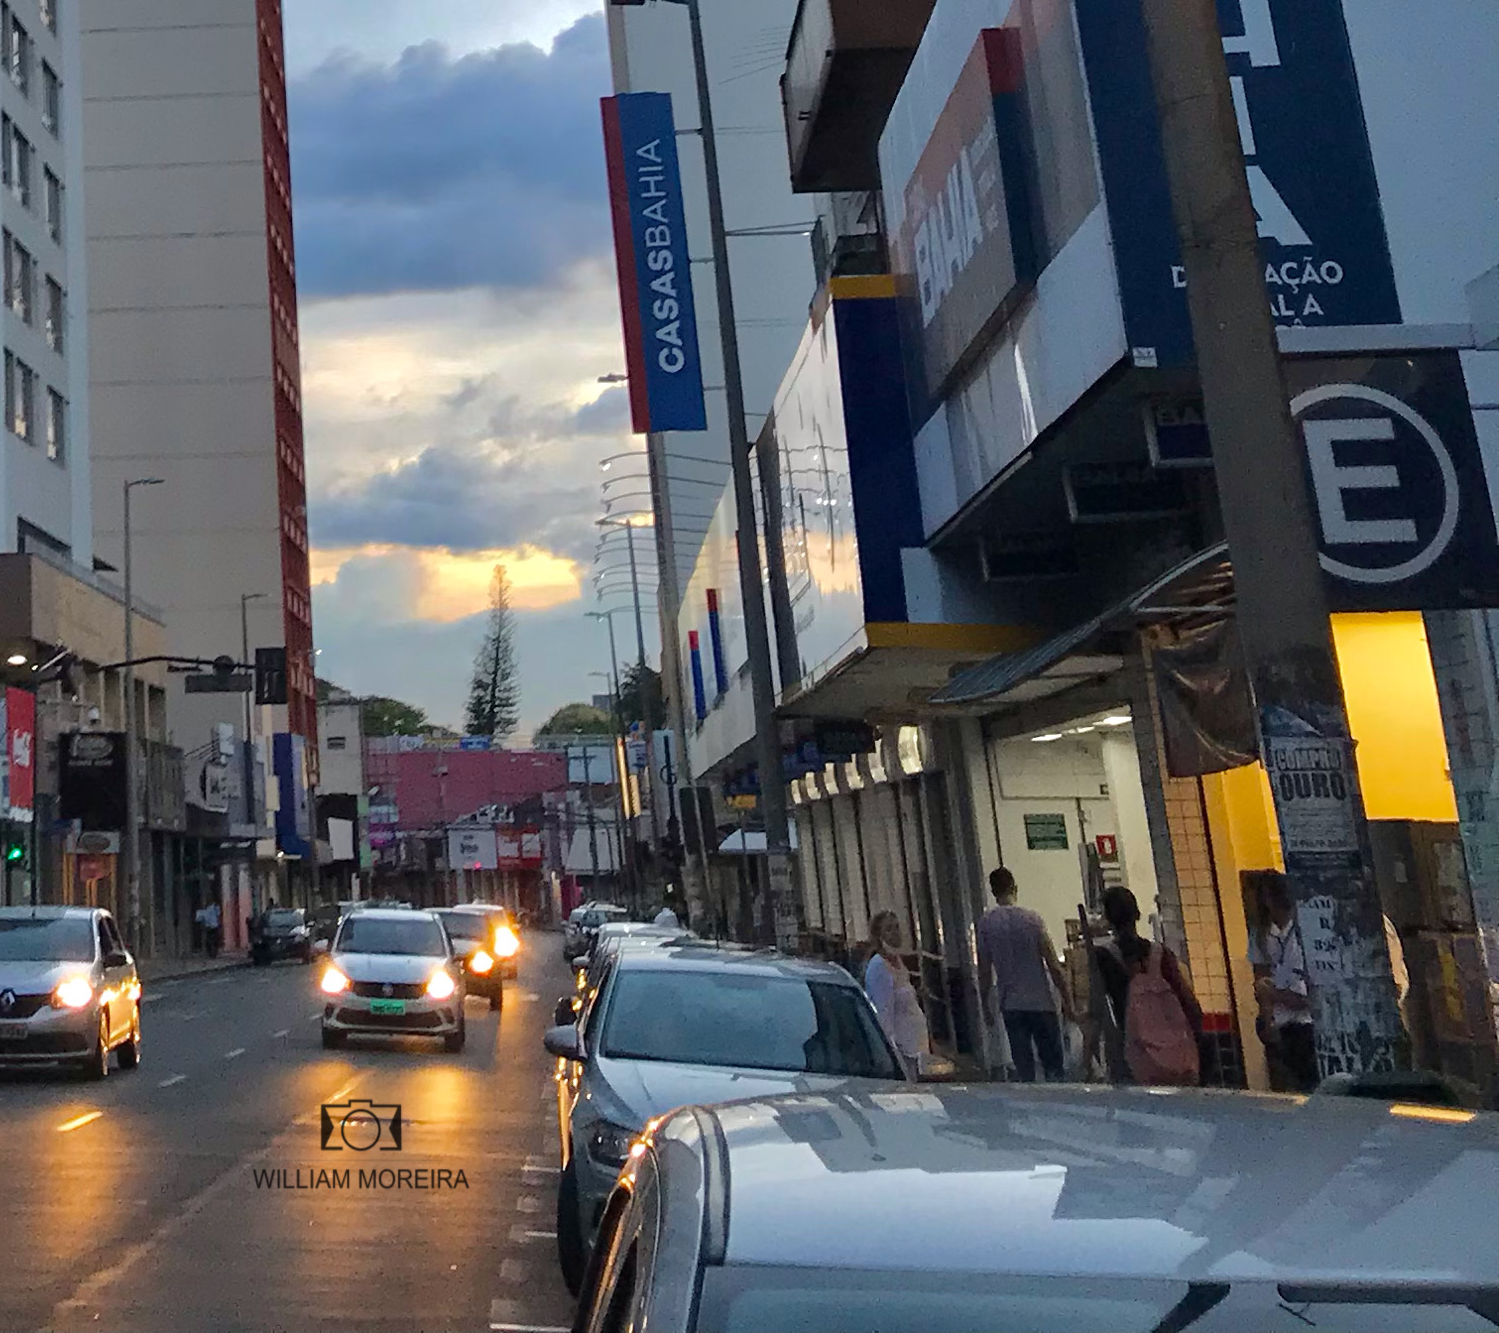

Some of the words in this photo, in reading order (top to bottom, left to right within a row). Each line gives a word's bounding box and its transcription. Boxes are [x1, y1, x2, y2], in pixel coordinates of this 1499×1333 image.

[636, 138, 686, 374] CASASBAHIA
[1171, 256, 1344, 294] DAÇÃO
[1302, 417, 1419, 544] E
[1280, 772, 1347, 801] OURO
